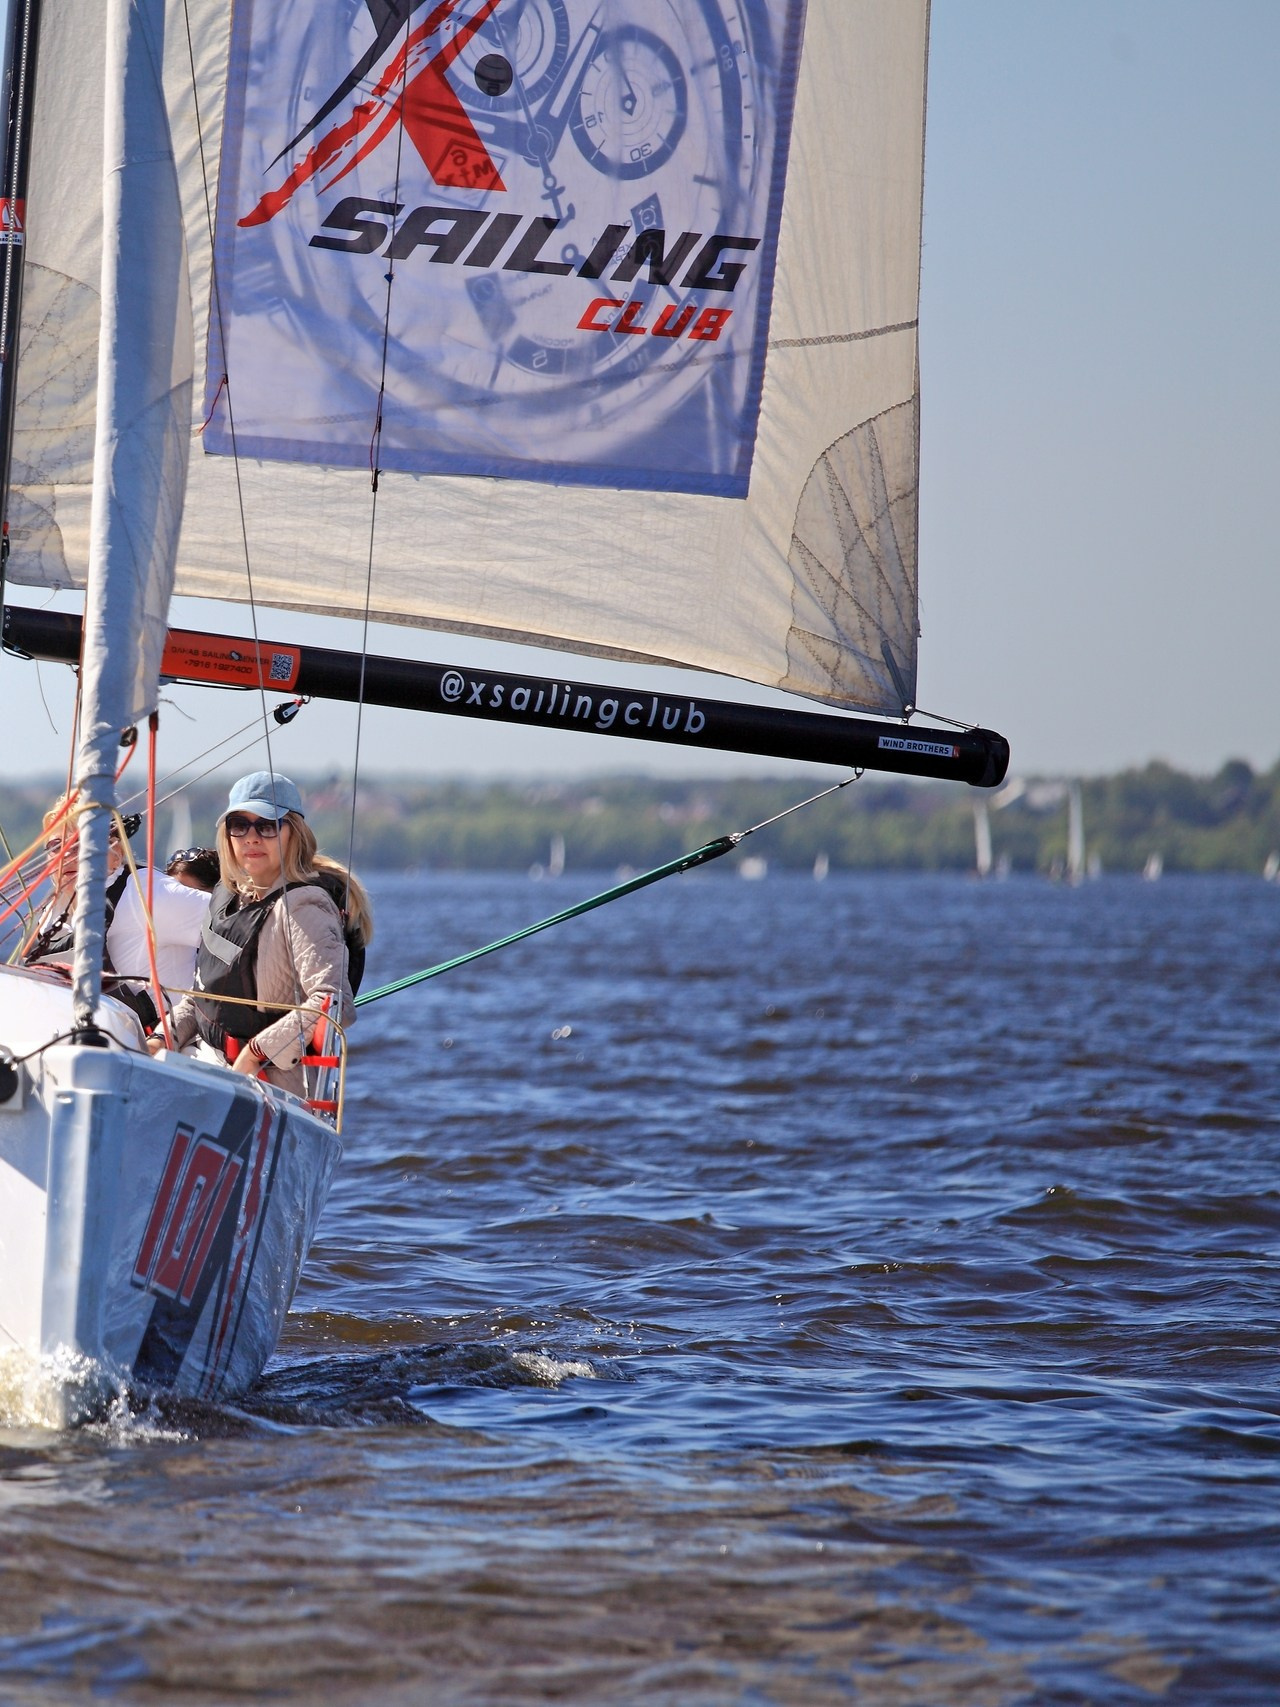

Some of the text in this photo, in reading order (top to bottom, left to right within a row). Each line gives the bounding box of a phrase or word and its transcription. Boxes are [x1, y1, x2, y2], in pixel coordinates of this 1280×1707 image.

[309, 197, 761, 292] SAILING
[576, 298, 733, 341] CLUB
[440, 670, 706, 733] @xsailingclub
[882, 739, 949, 754] WIND BROTHERS
[132, 1123, 243, 1306] 101
